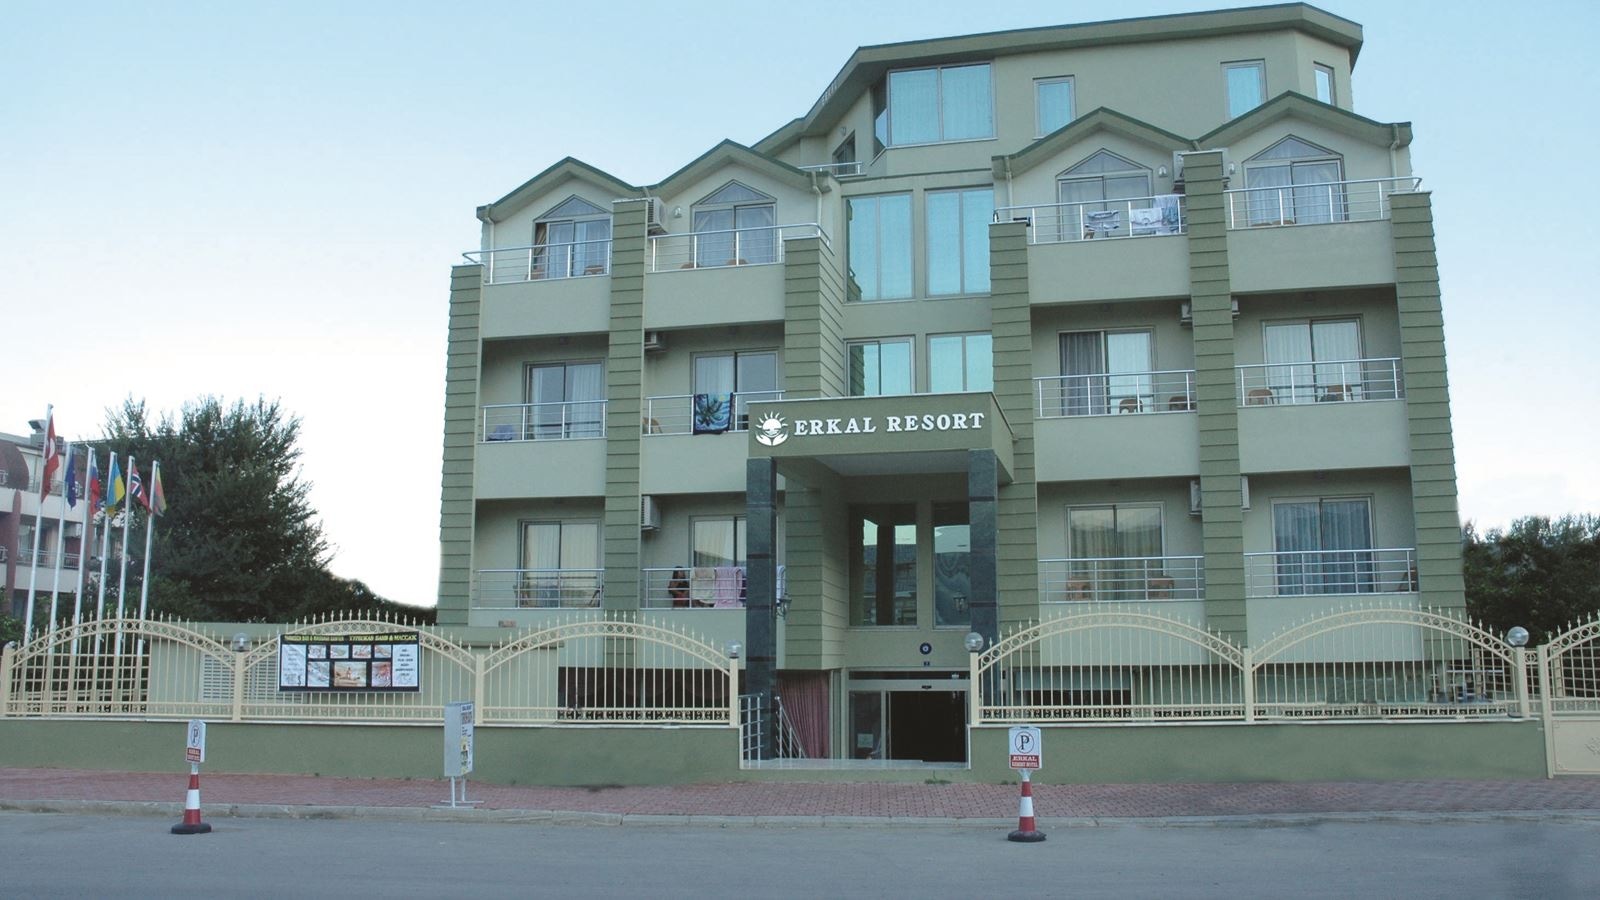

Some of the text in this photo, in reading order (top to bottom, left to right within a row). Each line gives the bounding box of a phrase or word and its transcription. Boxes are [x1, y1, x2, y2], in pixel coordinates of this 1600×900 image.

[794, 412, 985, 436] ERKAL RESORT
[1020, 735, 1030, 750] P
